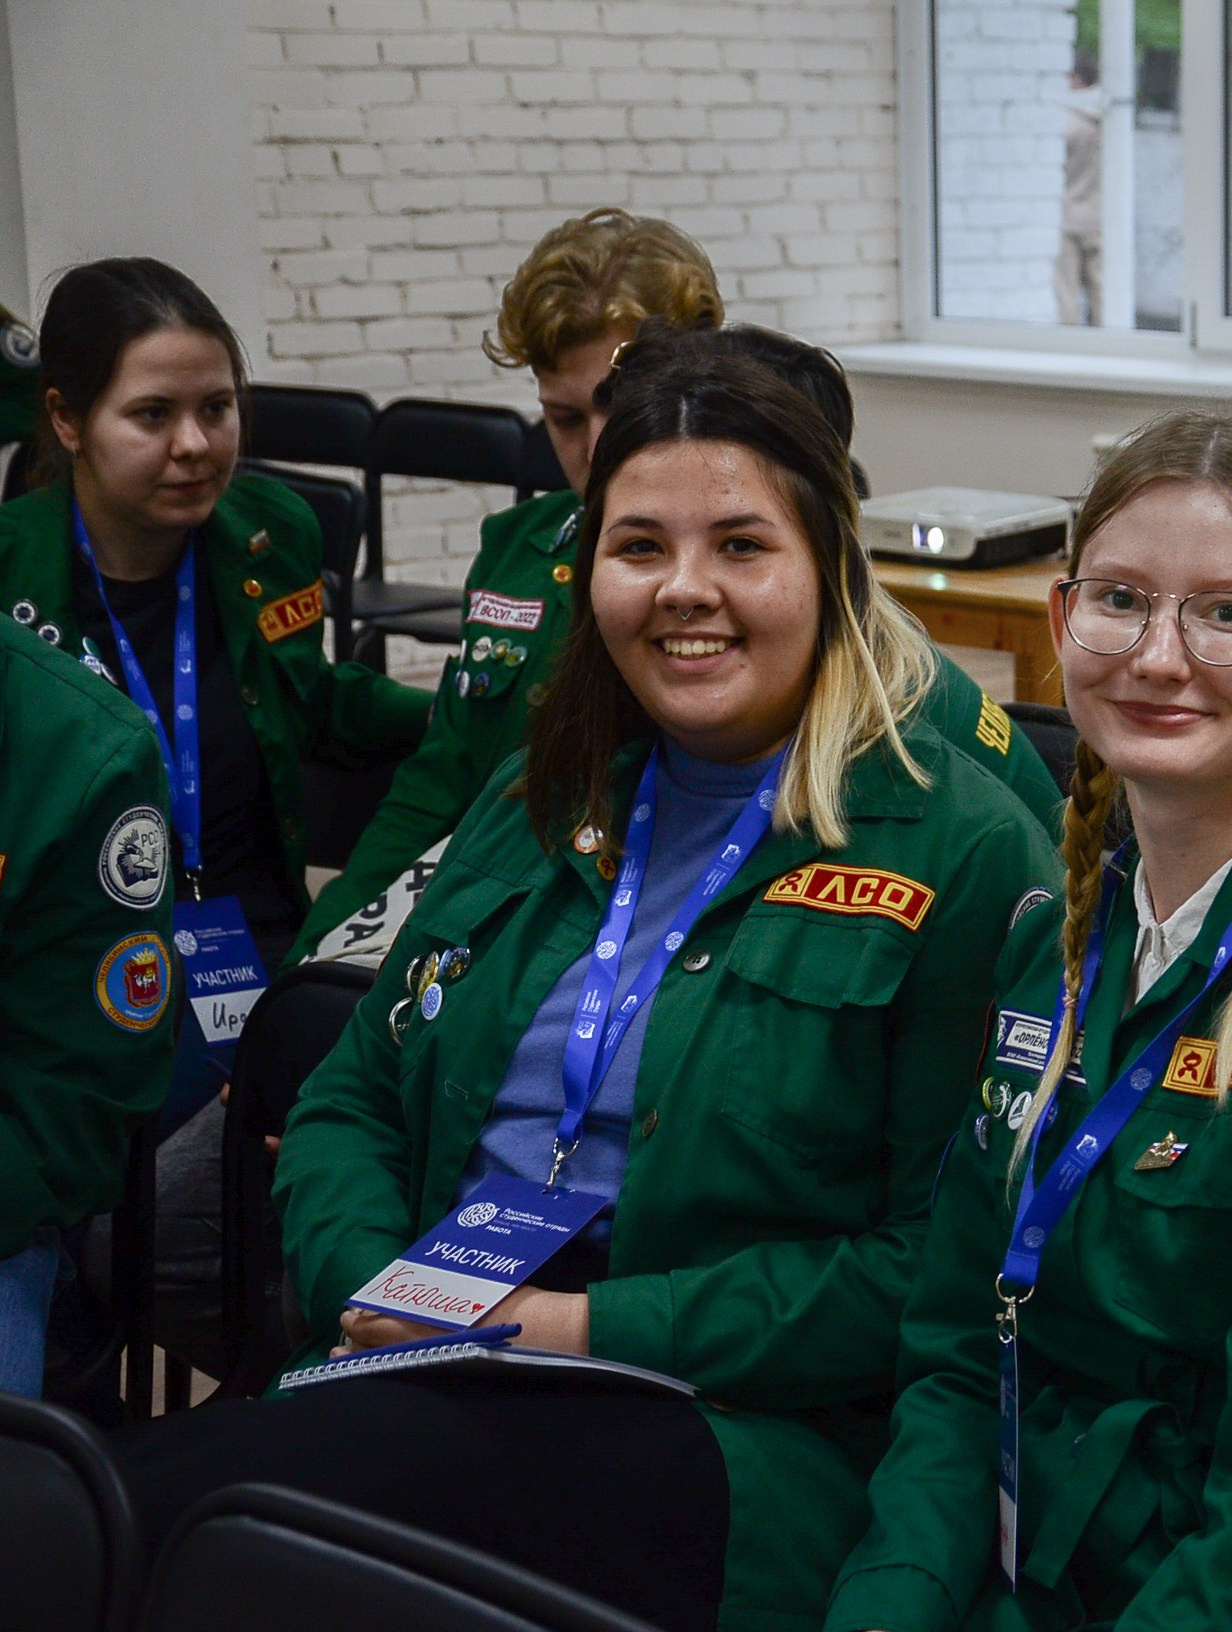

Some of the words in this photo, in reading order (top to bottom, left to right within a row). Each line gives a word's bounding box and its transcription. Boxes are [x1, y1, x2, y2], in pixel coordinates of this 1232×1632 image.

[976, 693, 1011, 755] ЧЕЛЯ
[816, 875, 914, 911] ЛСО
[192, 965, 258, 988] УЧАСТНИК
[485, 1224, 512, 1235] РАБОТА
[425, 1241, 526, 1275] УЧАСТНИК
